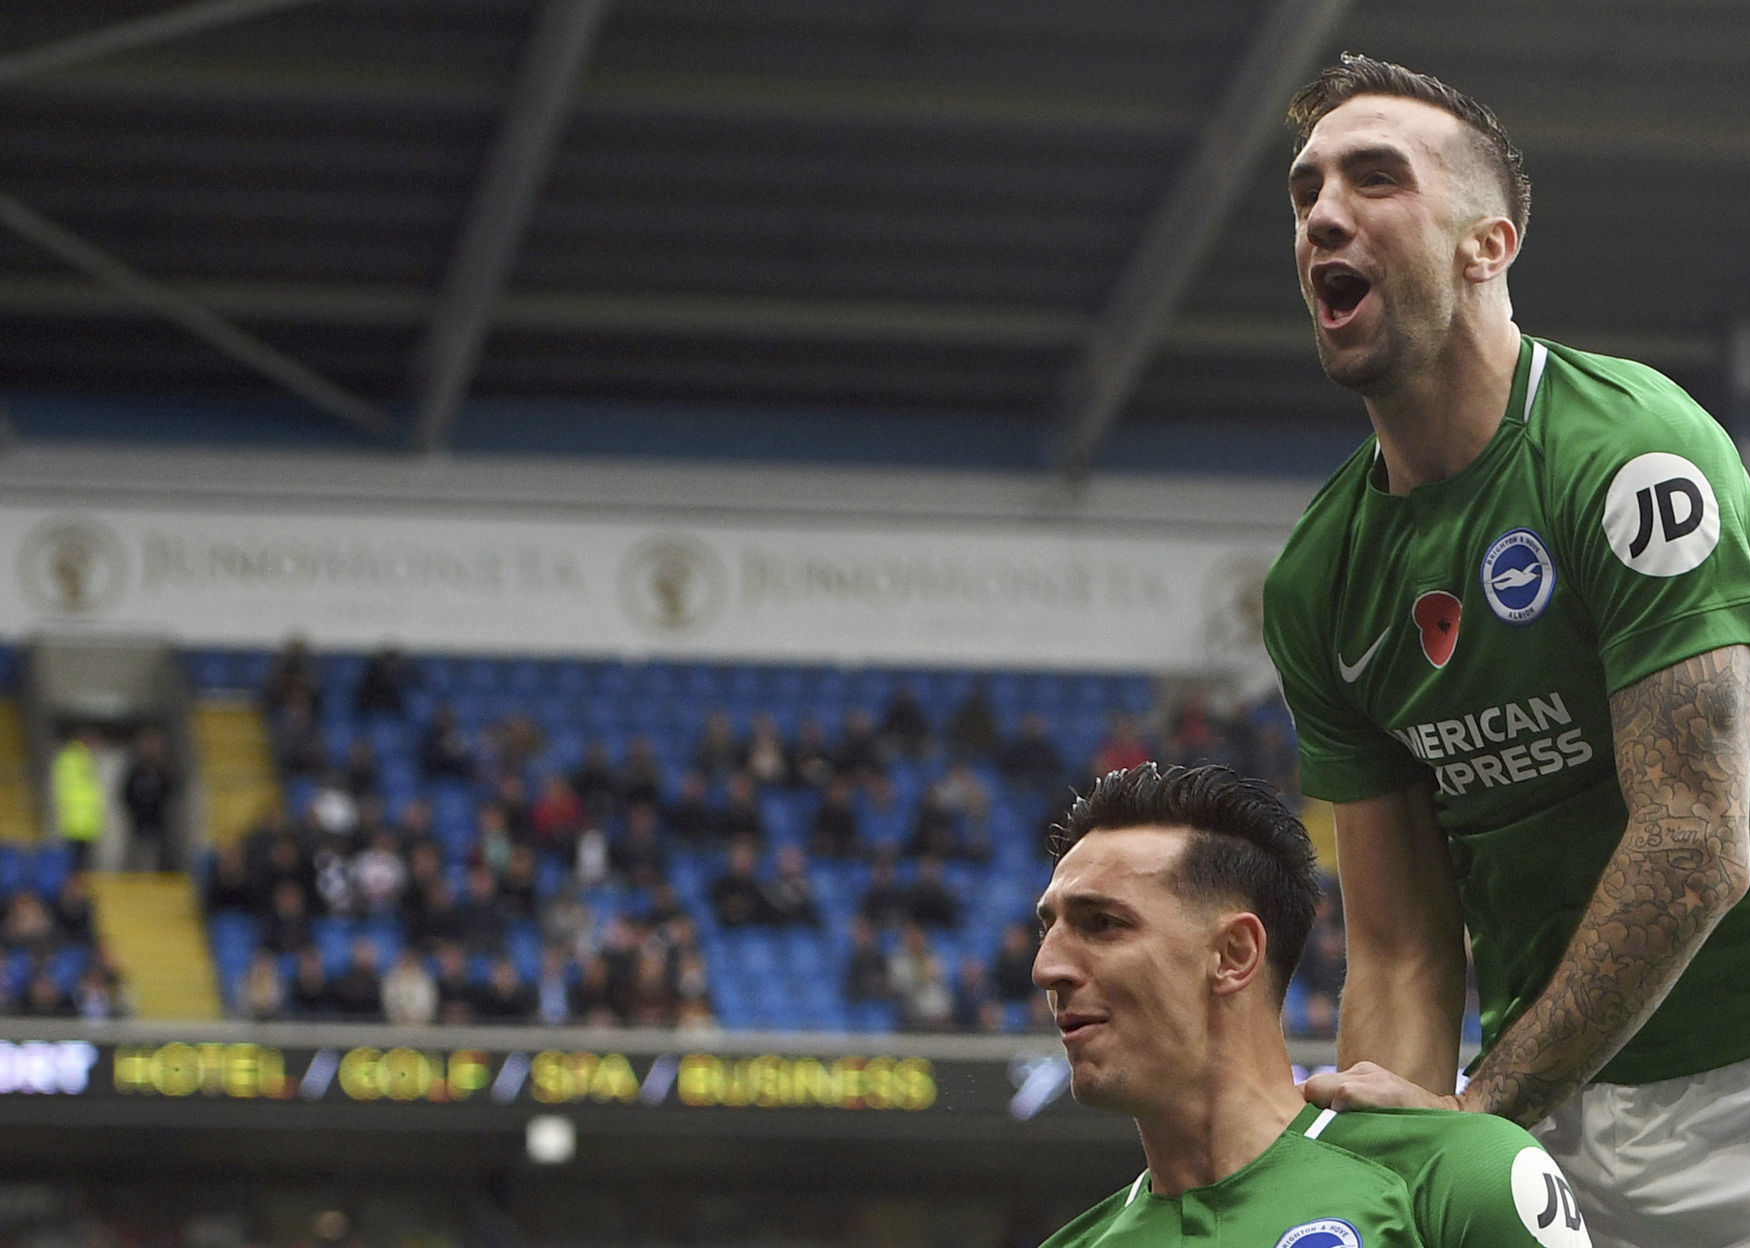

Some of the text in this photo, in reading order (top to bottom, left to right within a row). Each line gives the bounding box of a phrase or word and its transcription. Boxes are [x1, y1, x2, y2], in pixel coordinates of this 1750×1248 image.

[1487, 536, 1518, 565] BRIGHTON
[1630, 477, 1704, 559] JD
[1386, 692, 1573, 759] MERICAN
[1435, 728, 1593, 796] XPRESS
